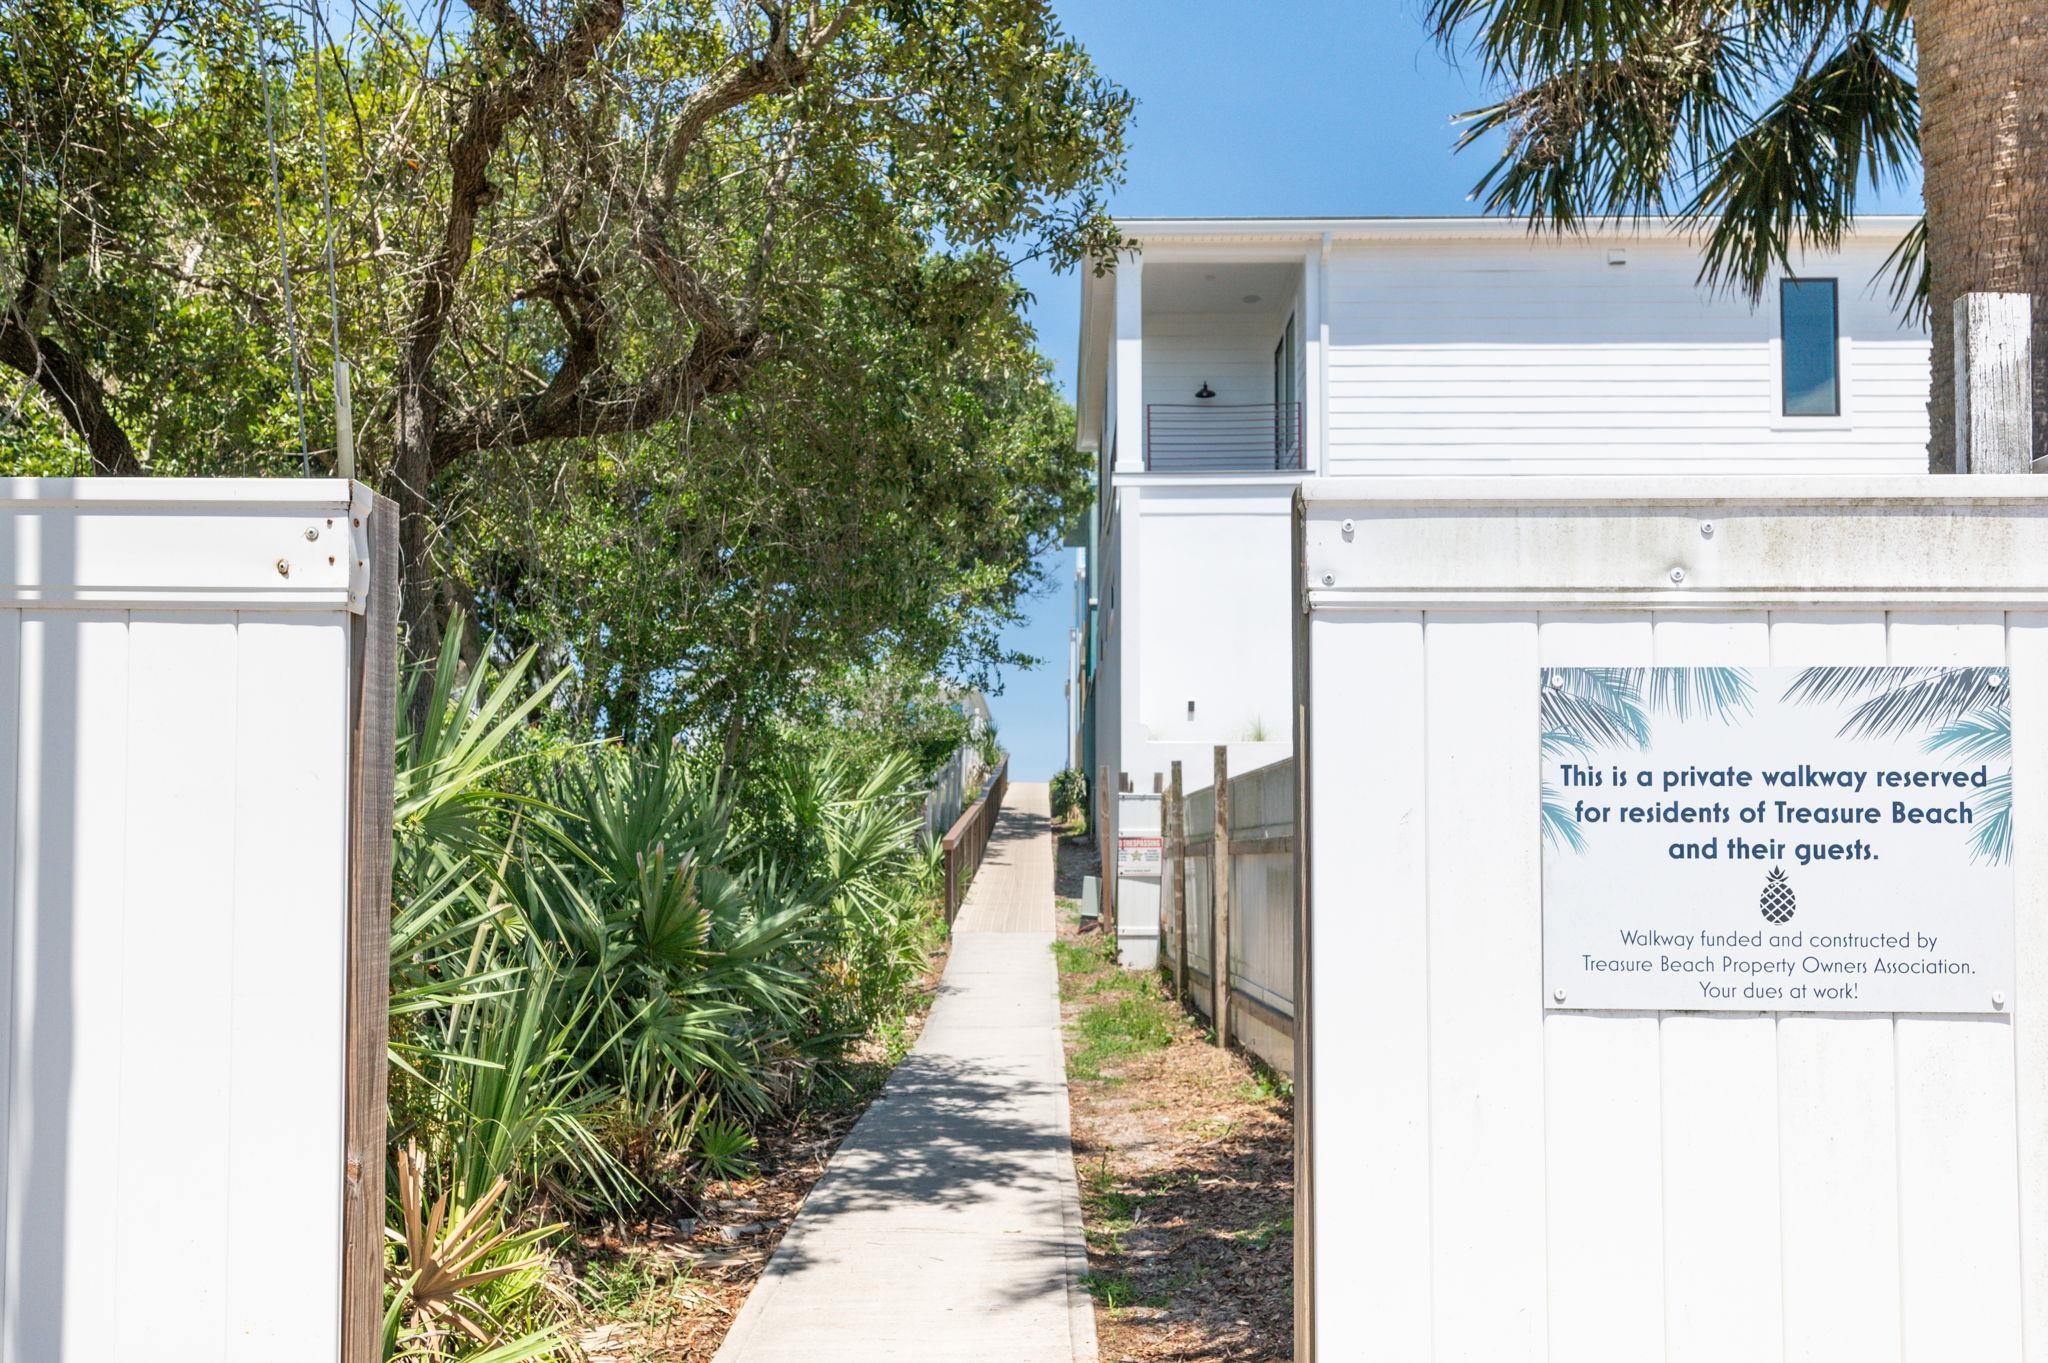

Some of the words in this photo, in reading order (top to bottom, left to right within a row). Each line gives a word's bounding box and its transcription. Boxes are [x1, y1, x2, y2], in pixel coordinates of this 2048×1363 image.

[1560, 765, 1602, 786] This
[1613, 766, 1627, 786] is
[1637, 771, 1652, 786] a
[1663, 766, 1752, 792] private
[1762, 765, 1867, 792] walkway
[1877, 765, 1987, 787] reserved
[1575, 801, 1610, 823] for
[1621, 801, 1729, 823] residents
[1740, 801, 1765, 823] of
[1775, 801, 1881, 823] Treasure
[1892, 801, 1973, 823] Beach
[1123, 839, 1160, 847] TRESPASSING
[1669, 837, 1717, 859] and
[1727, 837, 1785, 859] their
[1795, 839, 1878, 865] guests.
[1620, 930, 1694, 950] Walkway
[1701, 930, 1761, 947] funded
[1770, 931, 1801, 947] and
[1810, 932, 1909, 948] constructed
[1918, 932, 1937, 952] by
[1583, 955, 1652, 971] Treasure
[1662, 956, 1714, 972] Beach
[1723, 956, 1795, 976] Property
[1803, 957, 1867, 973] Owners
[1874, 958, 1975, 974] Association.
[1699, 982, 1736, 998] Your
[1744, 982, 1782, 998] dues
[1790, 985, 1806, 998] at
[1814, 983, 1857, 999] work!
